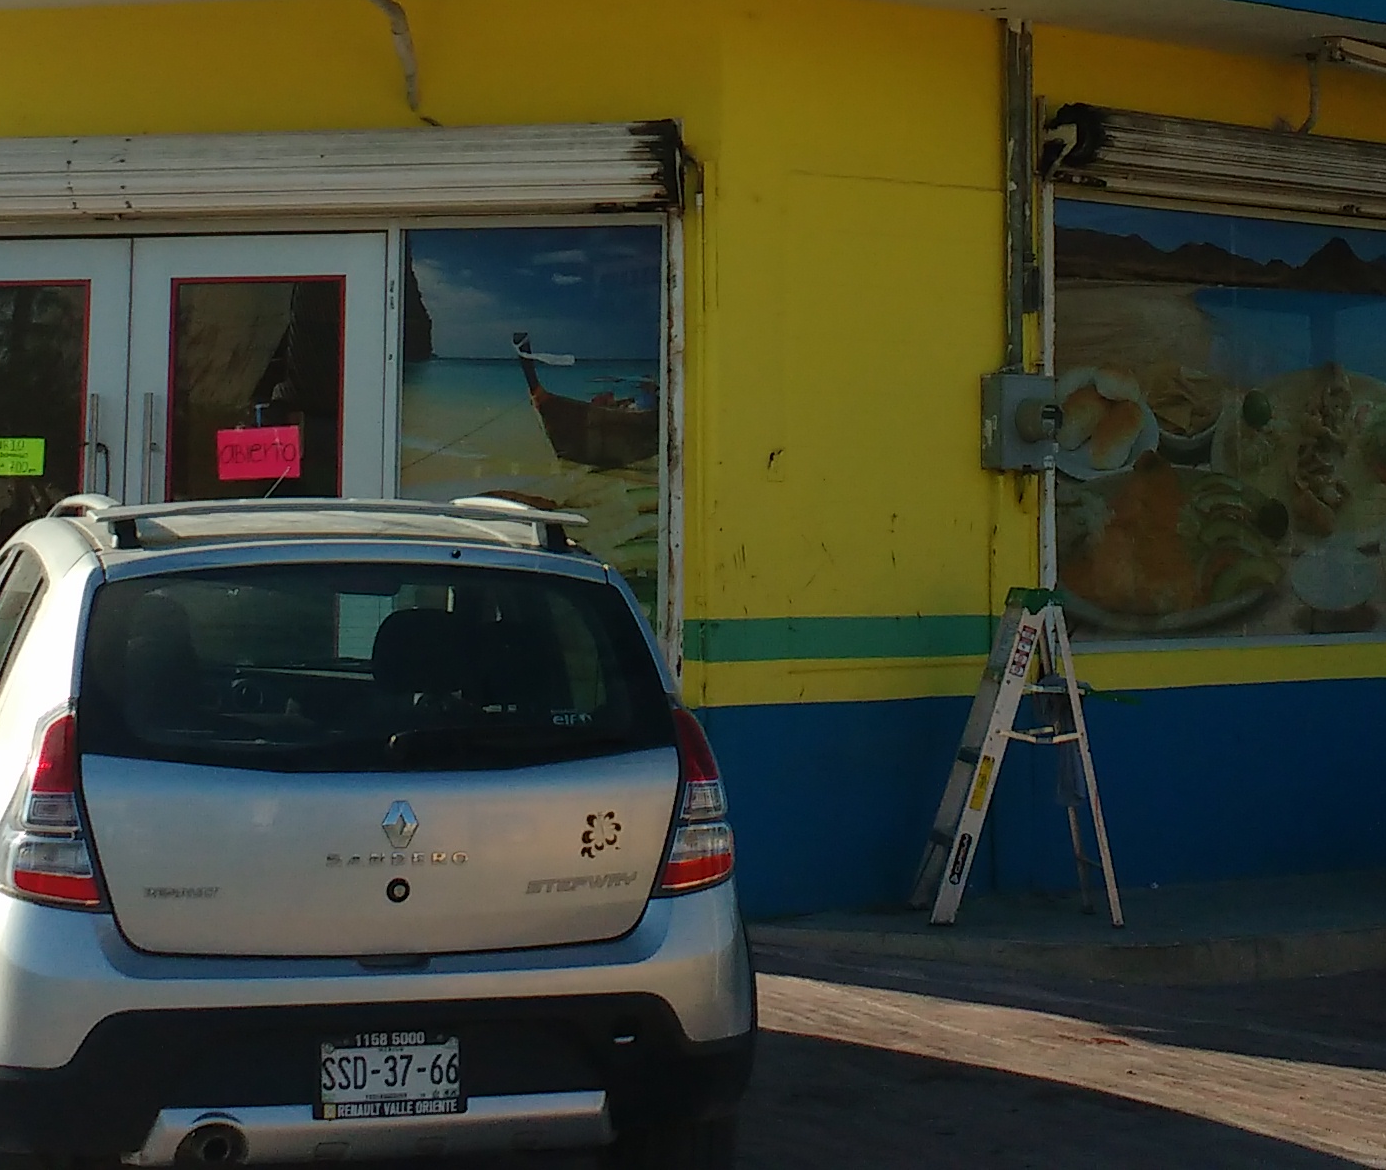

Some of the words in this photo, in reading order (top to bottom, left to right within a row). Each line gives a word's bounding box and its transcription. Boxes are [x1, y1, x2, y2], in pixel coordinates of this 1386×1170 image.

[326, 851, 469, 867] SANDERO
[525, 871, 638, 895] STEPWAY
[392, 1031, 425, 1045] 5000
[322, 1053, 459, 1090] SSD-37-66
[337, 1103, 381, 1117] RENAULT
[383, 1101, 414, 1115] VALLE
[416, 1099, 458, 1114] ORIENTE
